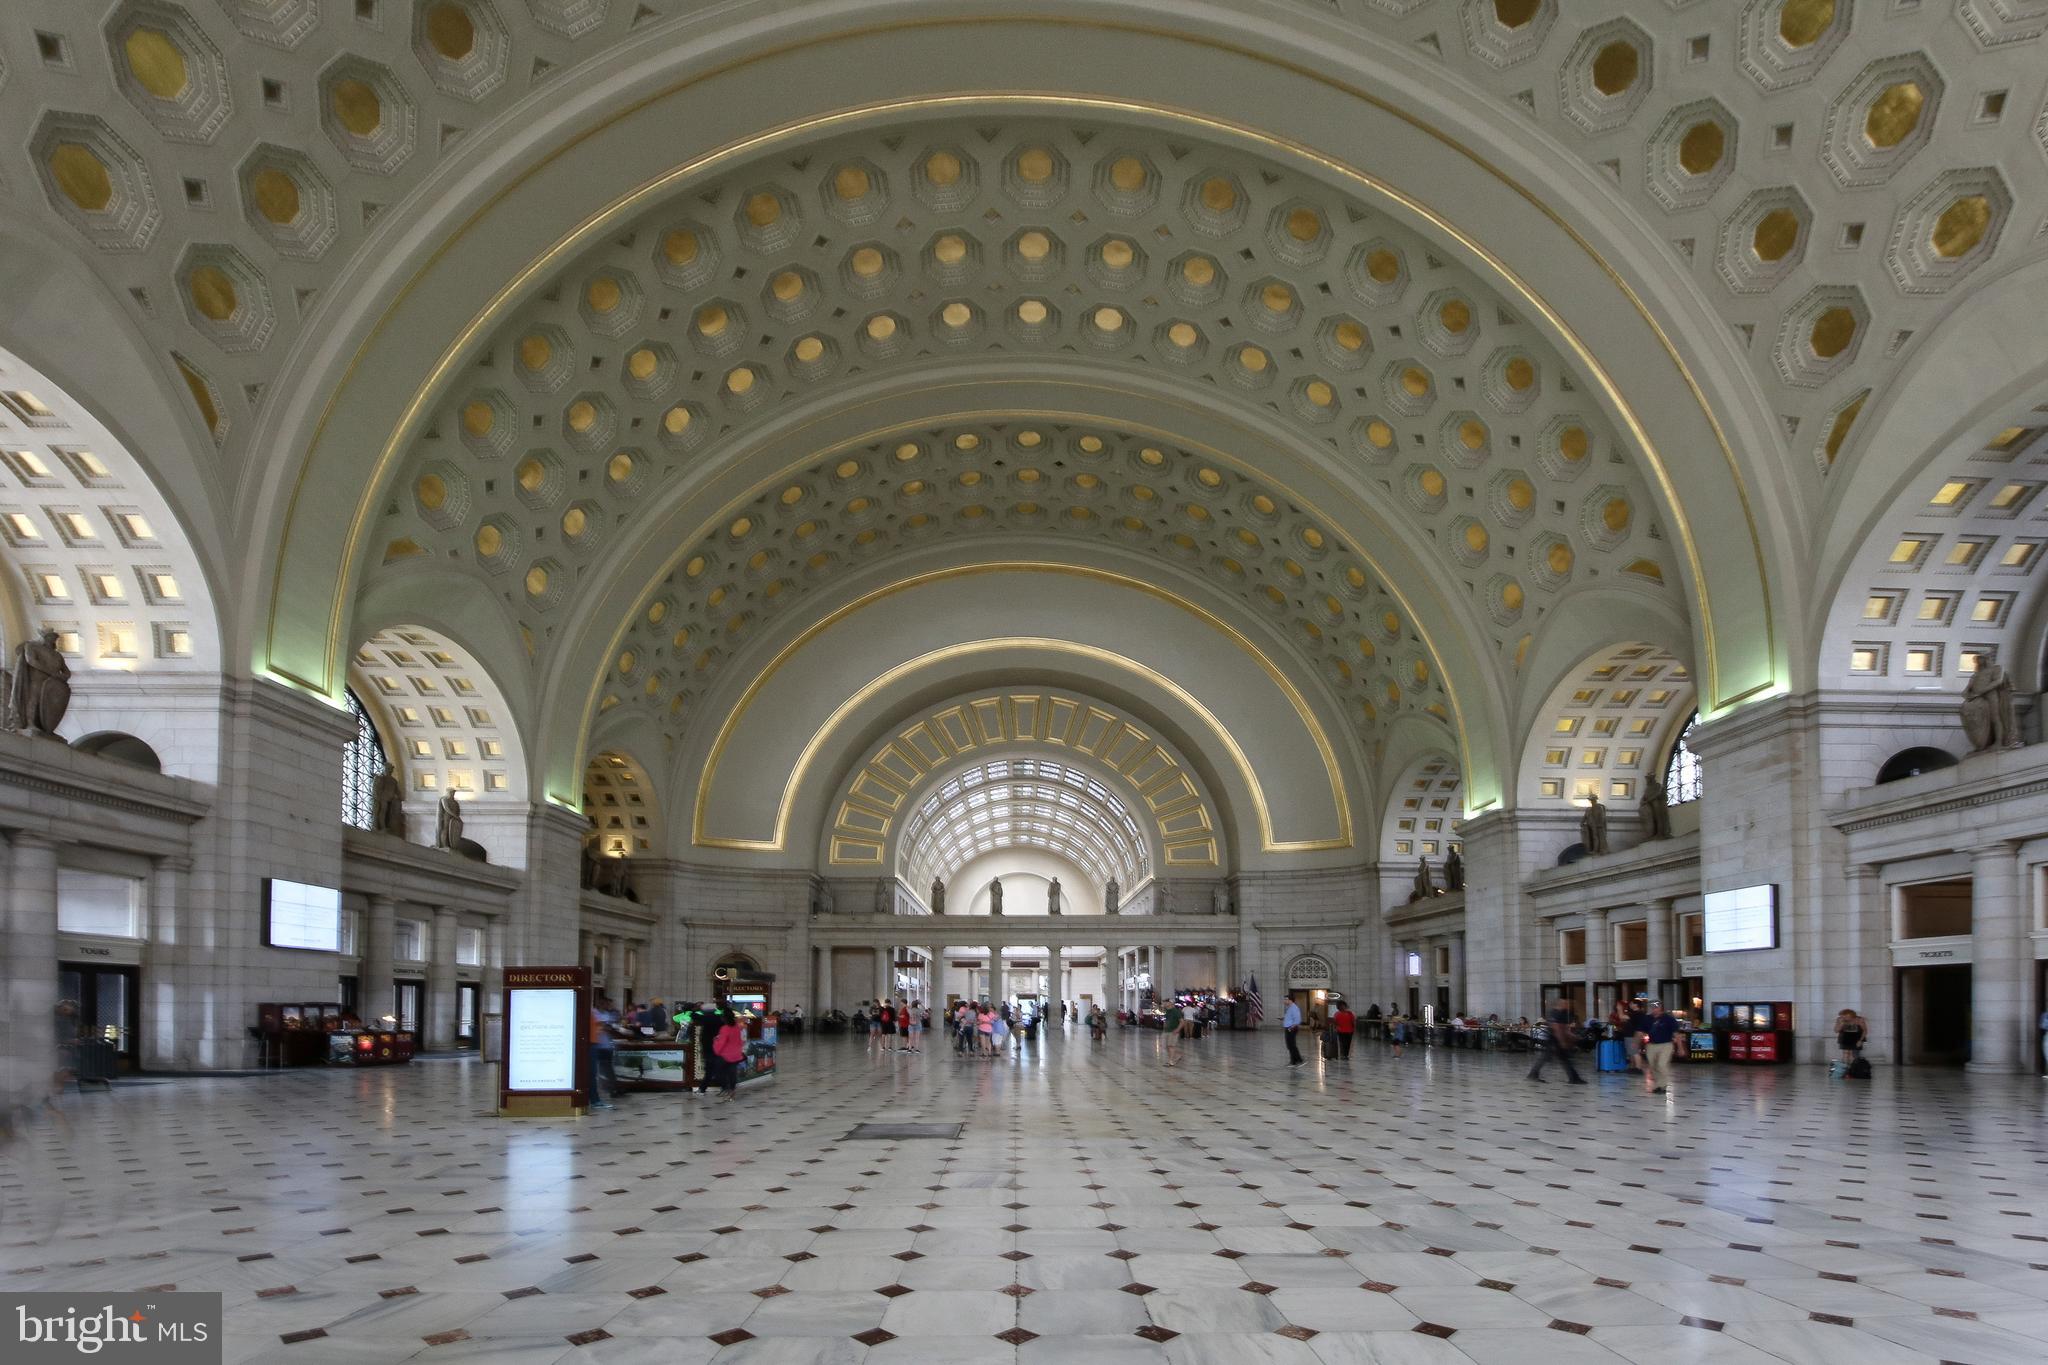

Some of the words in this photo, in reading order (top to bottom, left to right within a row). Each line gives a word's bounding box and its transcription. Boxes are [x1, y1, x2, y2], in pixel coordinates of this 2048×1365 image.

[79, 946, 110, 955] TOURS
[1919, 950, 1953, 958] TICKETS
[509, 974, 574, 982] DIRECTORY
